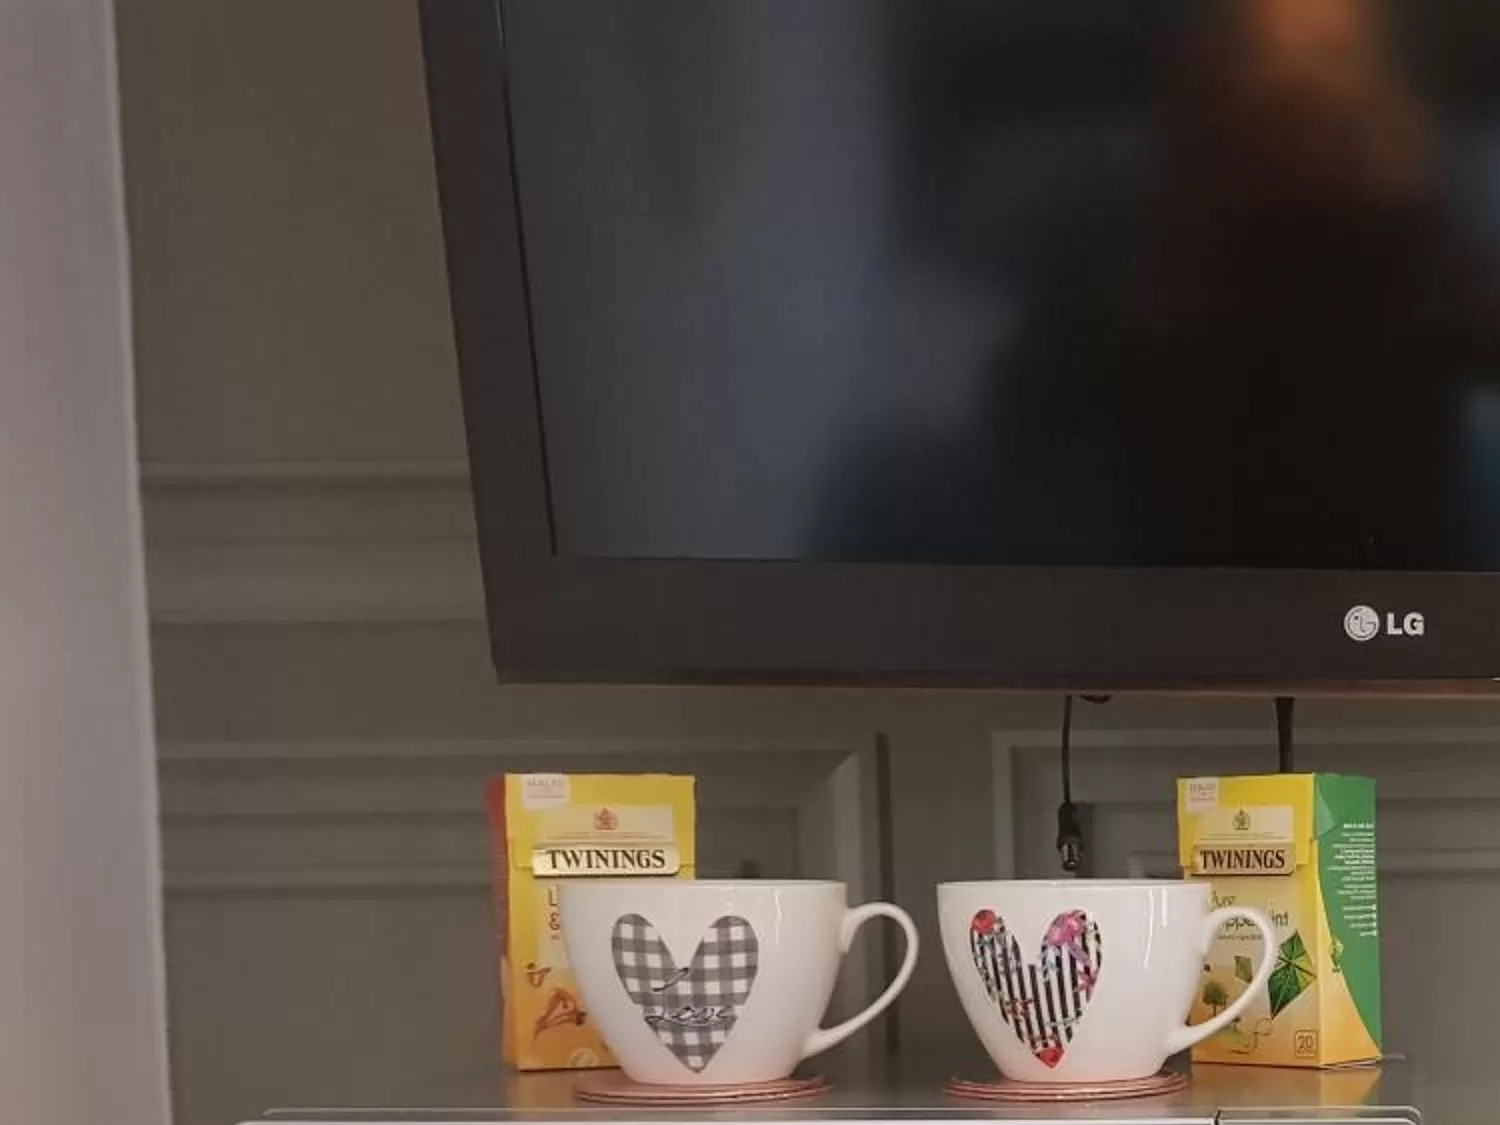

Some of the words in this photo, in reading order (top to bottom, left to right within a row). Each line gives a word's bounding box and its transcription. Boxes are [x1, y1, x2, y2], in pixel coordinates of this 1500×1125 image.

[1387, 612, 1425, 636] LG
[547, 849, 666, 869] TWININGS
[1201, 850, 1286, 869] TWININGS
